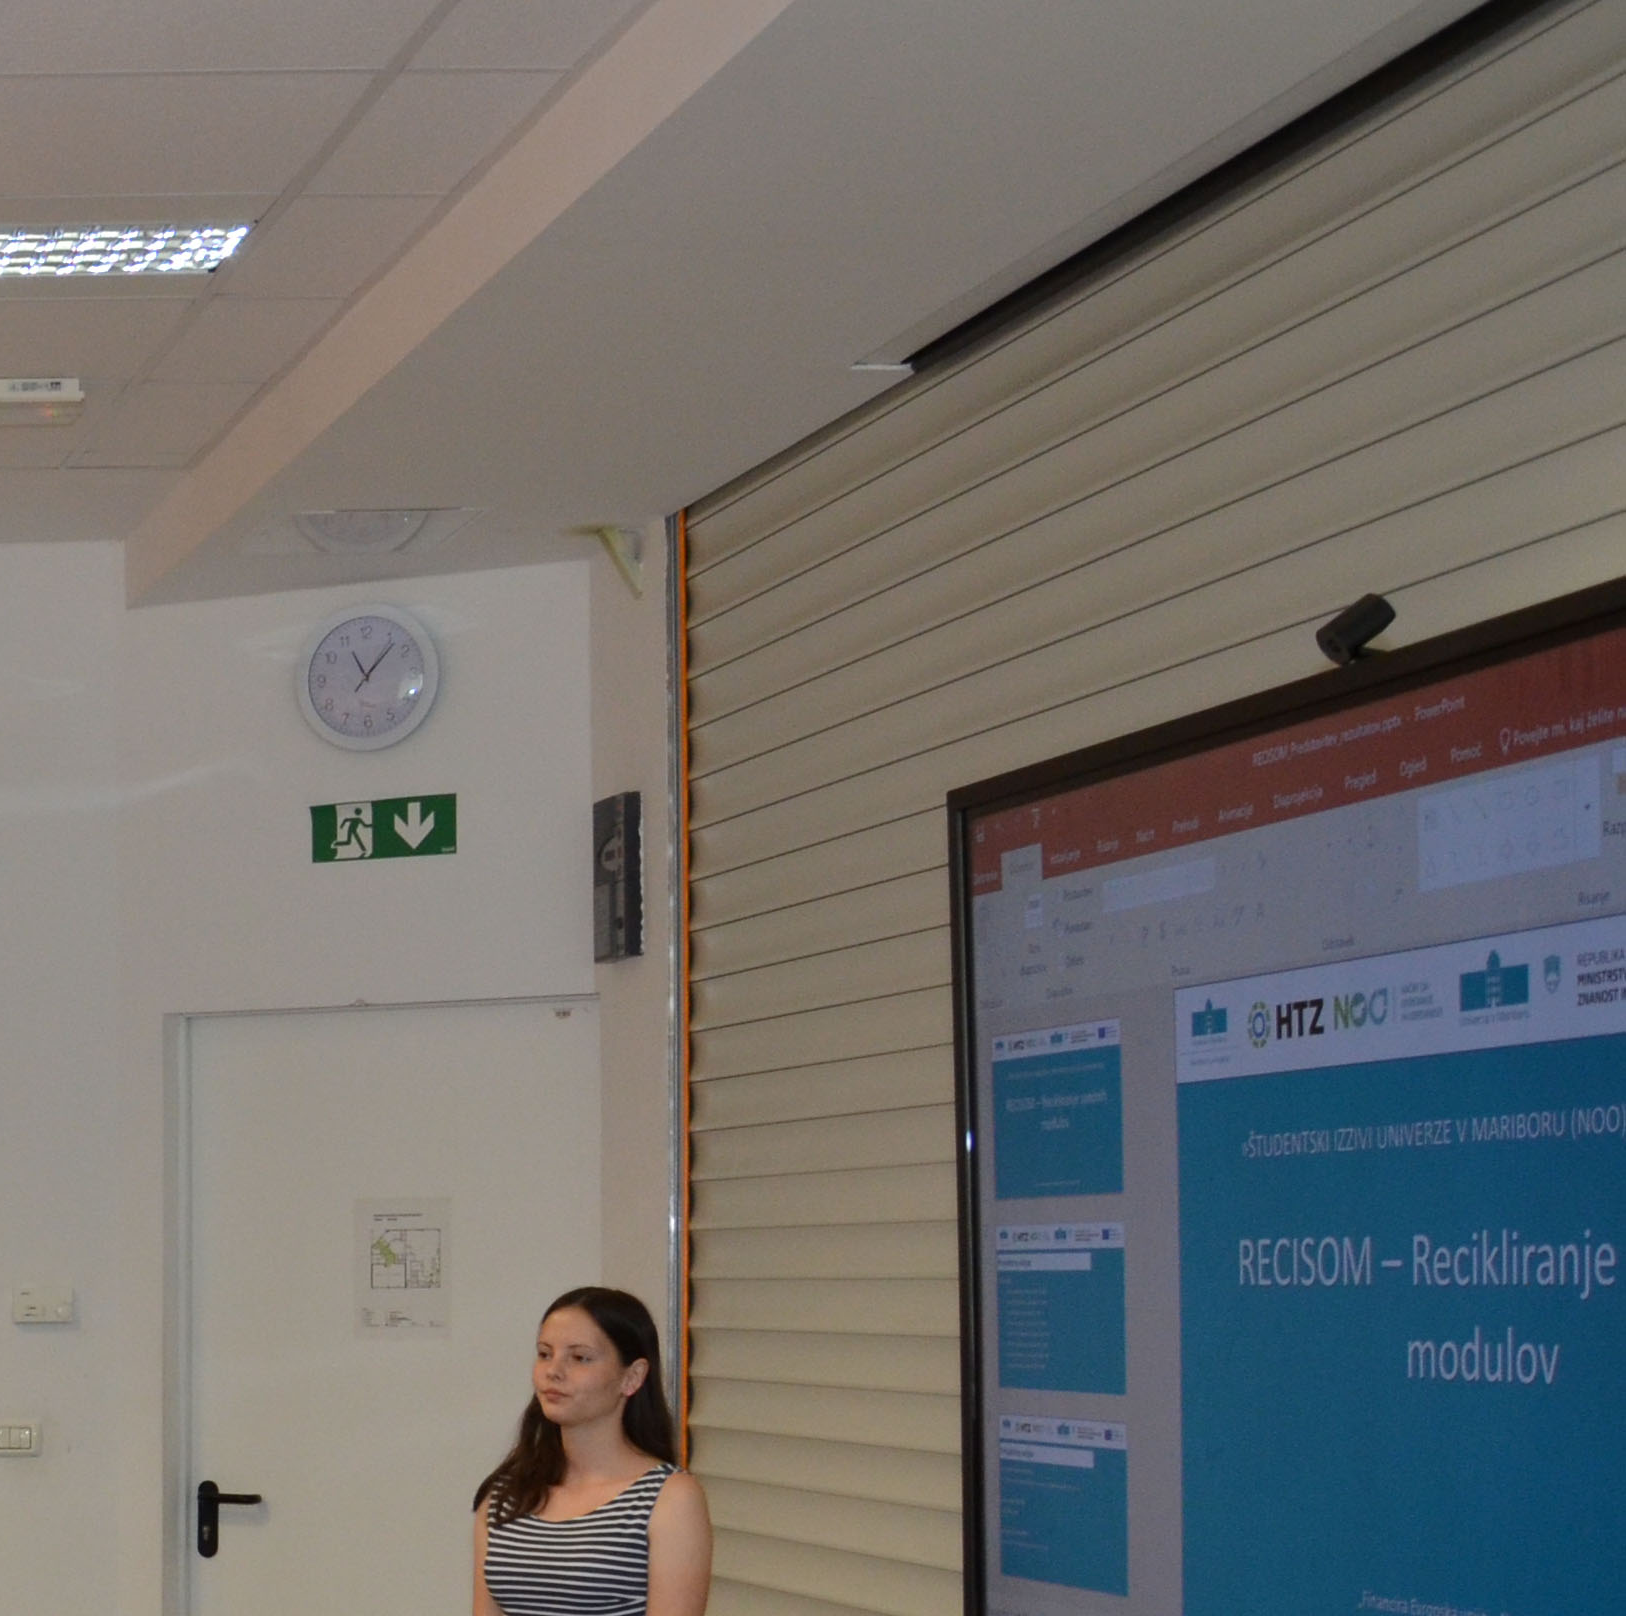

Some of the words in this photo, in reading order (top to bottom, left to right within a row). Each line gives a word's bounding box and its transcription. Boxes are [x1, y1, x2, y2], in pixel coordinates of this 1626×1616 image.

[1275, 998, 1325, 1040] HTZ
[1334, 1127, 1373, 1151] IZZIVI
[1376, 1119, 1452, 1149] UNIVERZE
[1455, 1118, 1468, 1143] V
[1471, 1111, 1565, 1142] MARIBORU
[1238, 1236, 1372, 1286] RECISOM
[1412, 1228, 1617, 1300] Recikliranje
[1407, 1325, 1560, 1384] modulov
